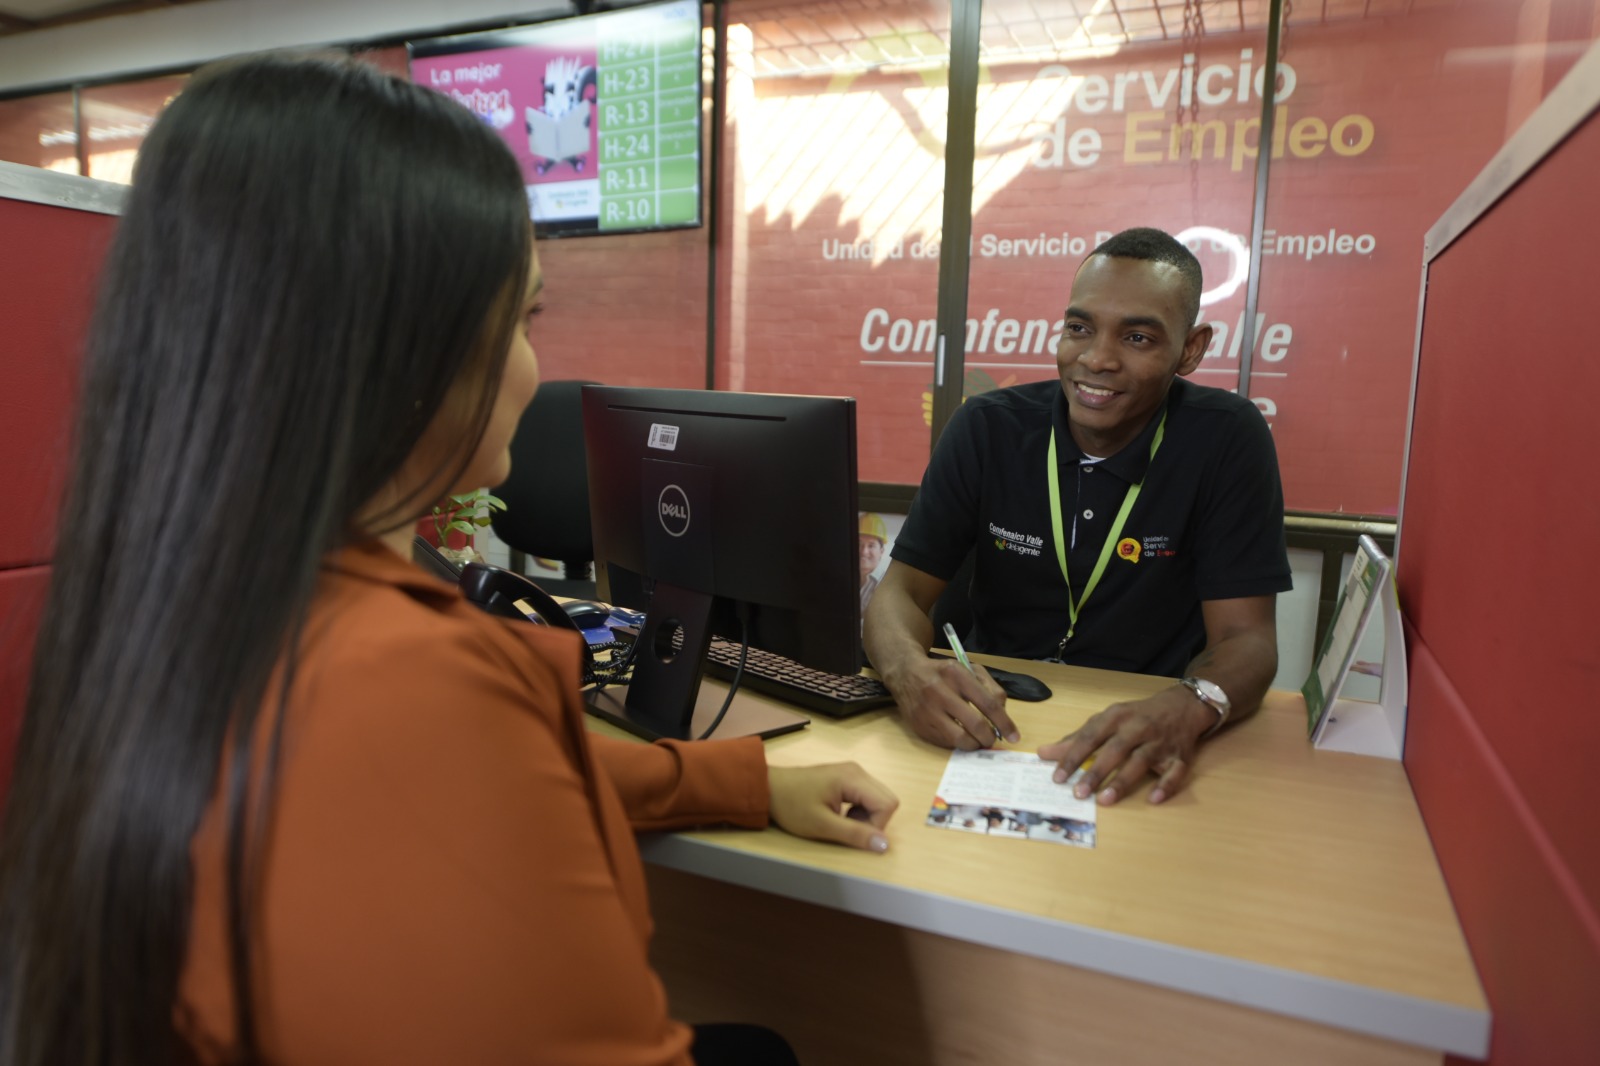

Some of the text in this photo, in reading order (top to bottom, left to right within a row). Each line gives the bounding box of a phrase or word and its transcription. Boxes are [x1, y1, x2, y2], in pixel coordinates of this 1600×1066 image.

[431, 62, 502, 86] La mejor
[604, 67, 650, 93] H-23
[605, 100, 650, 127] R-13
[604, 134, 650, 160] H-24
[1031, 104, 1375, 172] de Empleo
[606, 167, 649, 190] R-11
[606, 199, 650, 222] R-10
[822, 237, 904, 260] Unidd
[980, 232, 1086, 257] Servicio
[1261, 229, 1376, 261] Empleo
[661, 502, 687, 519] DELL
[989, 522, 1044, 547] Comfenalco Valle
